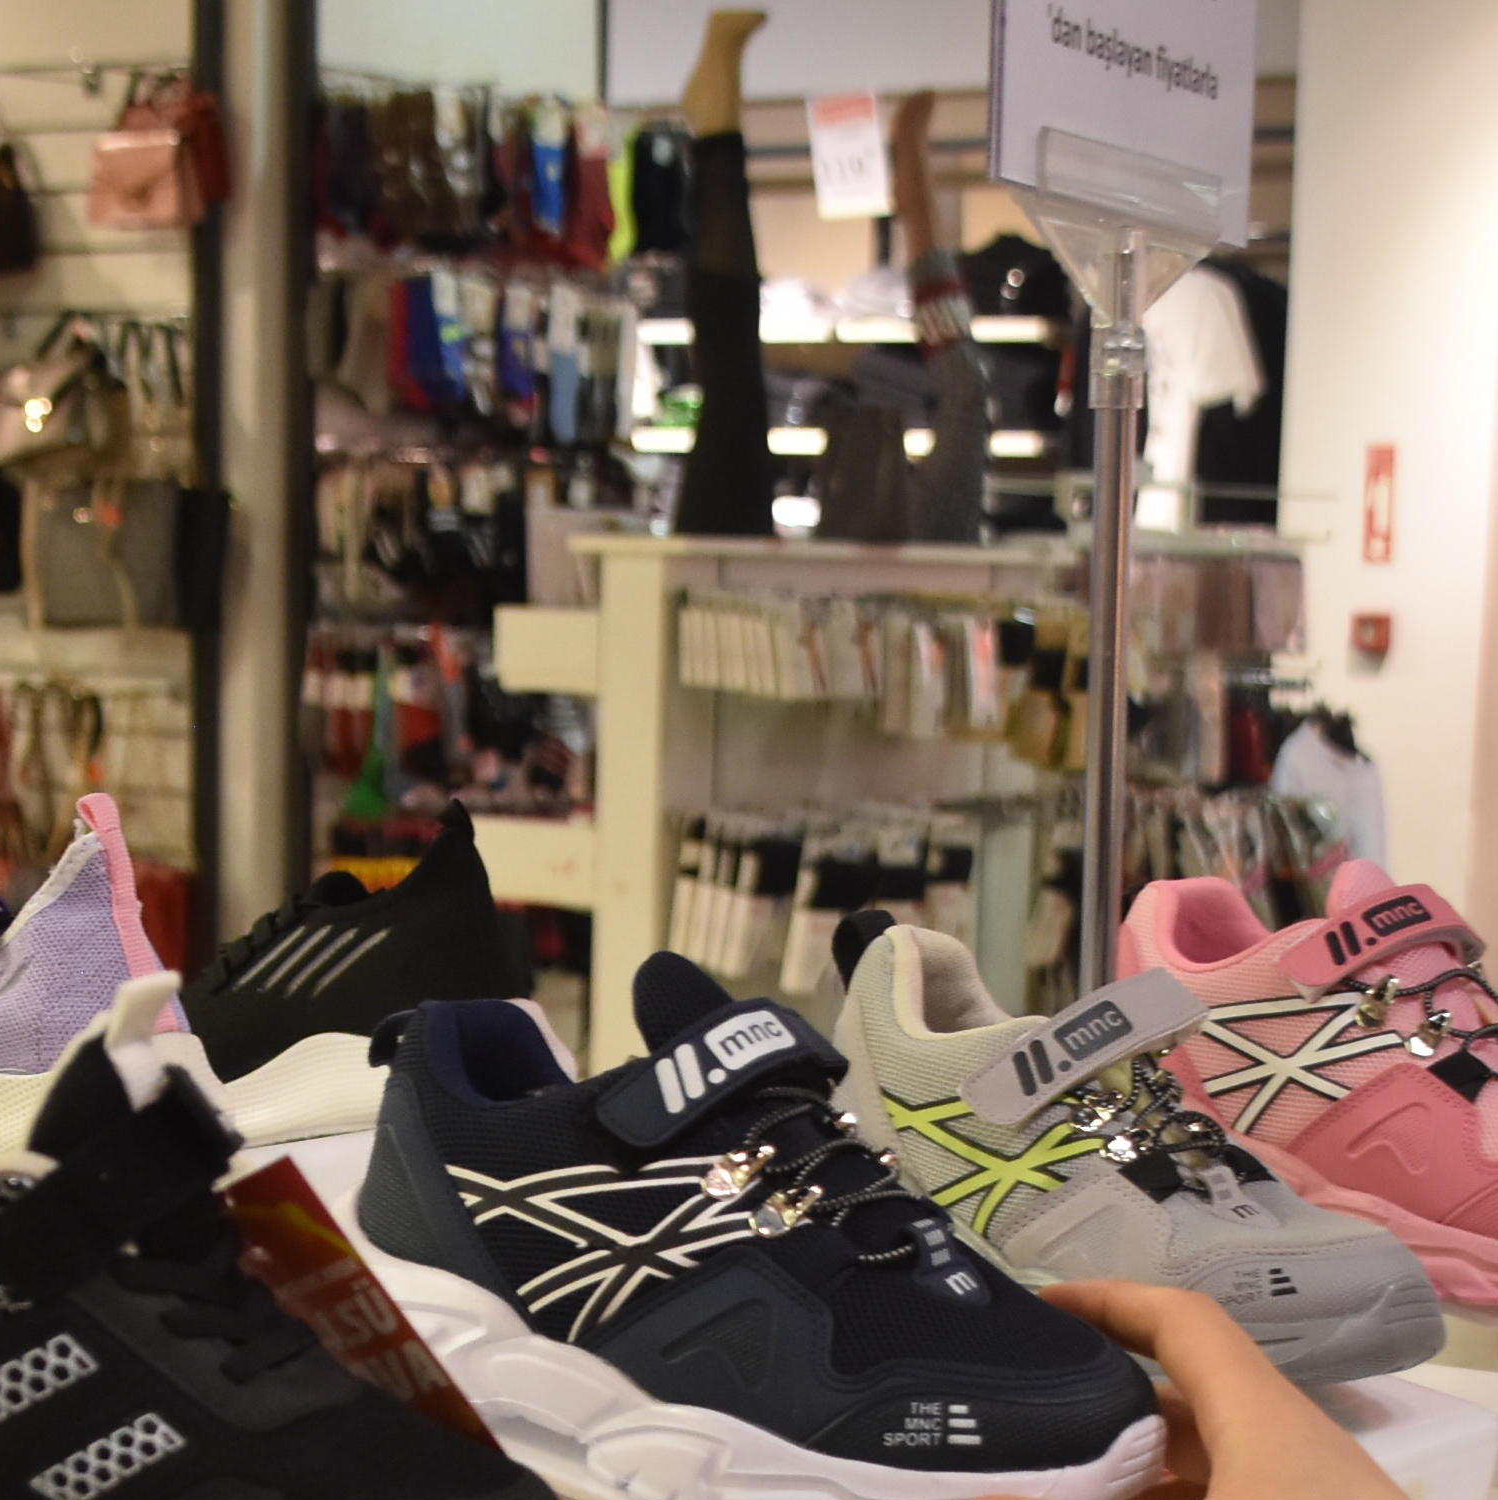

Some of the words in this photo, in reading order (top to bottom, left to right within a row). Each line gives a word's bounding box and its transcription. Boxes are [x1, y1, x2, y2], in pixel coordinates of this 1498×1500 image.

[1370, 902, 1424, 930] mnc
[718, 1020, 783, 1057] mnc
[1063, 1010, 1124, 1051] mnc
[944, 1271, 979, 1296] m
[910, 1402, 943, 1416] THE
[904, 1417, 943, 1431] MNC
[883, 1432, 943, 1447] SPORT
